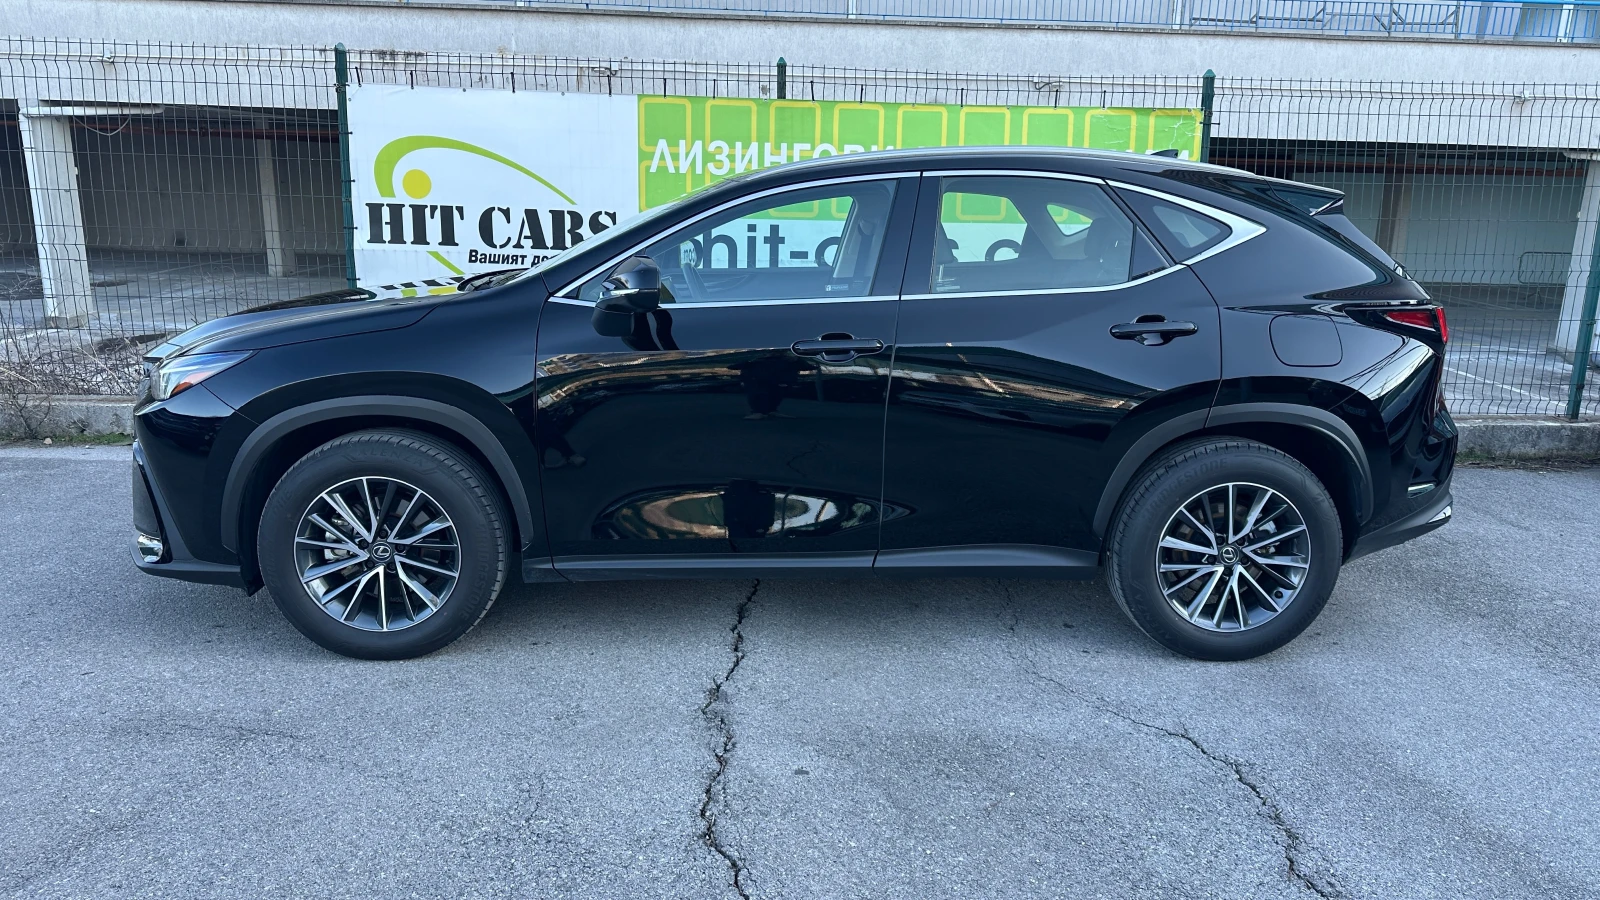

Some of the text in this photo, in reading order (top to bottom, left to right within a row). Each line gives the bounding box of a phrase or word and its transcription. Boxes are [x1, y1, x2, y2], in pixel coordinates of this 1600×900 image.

[650, 138, 895, 175] ЛИЗИНГ
[365, 203, 464, 246] HIT
[468, 249, 555, 268] Вашият до
